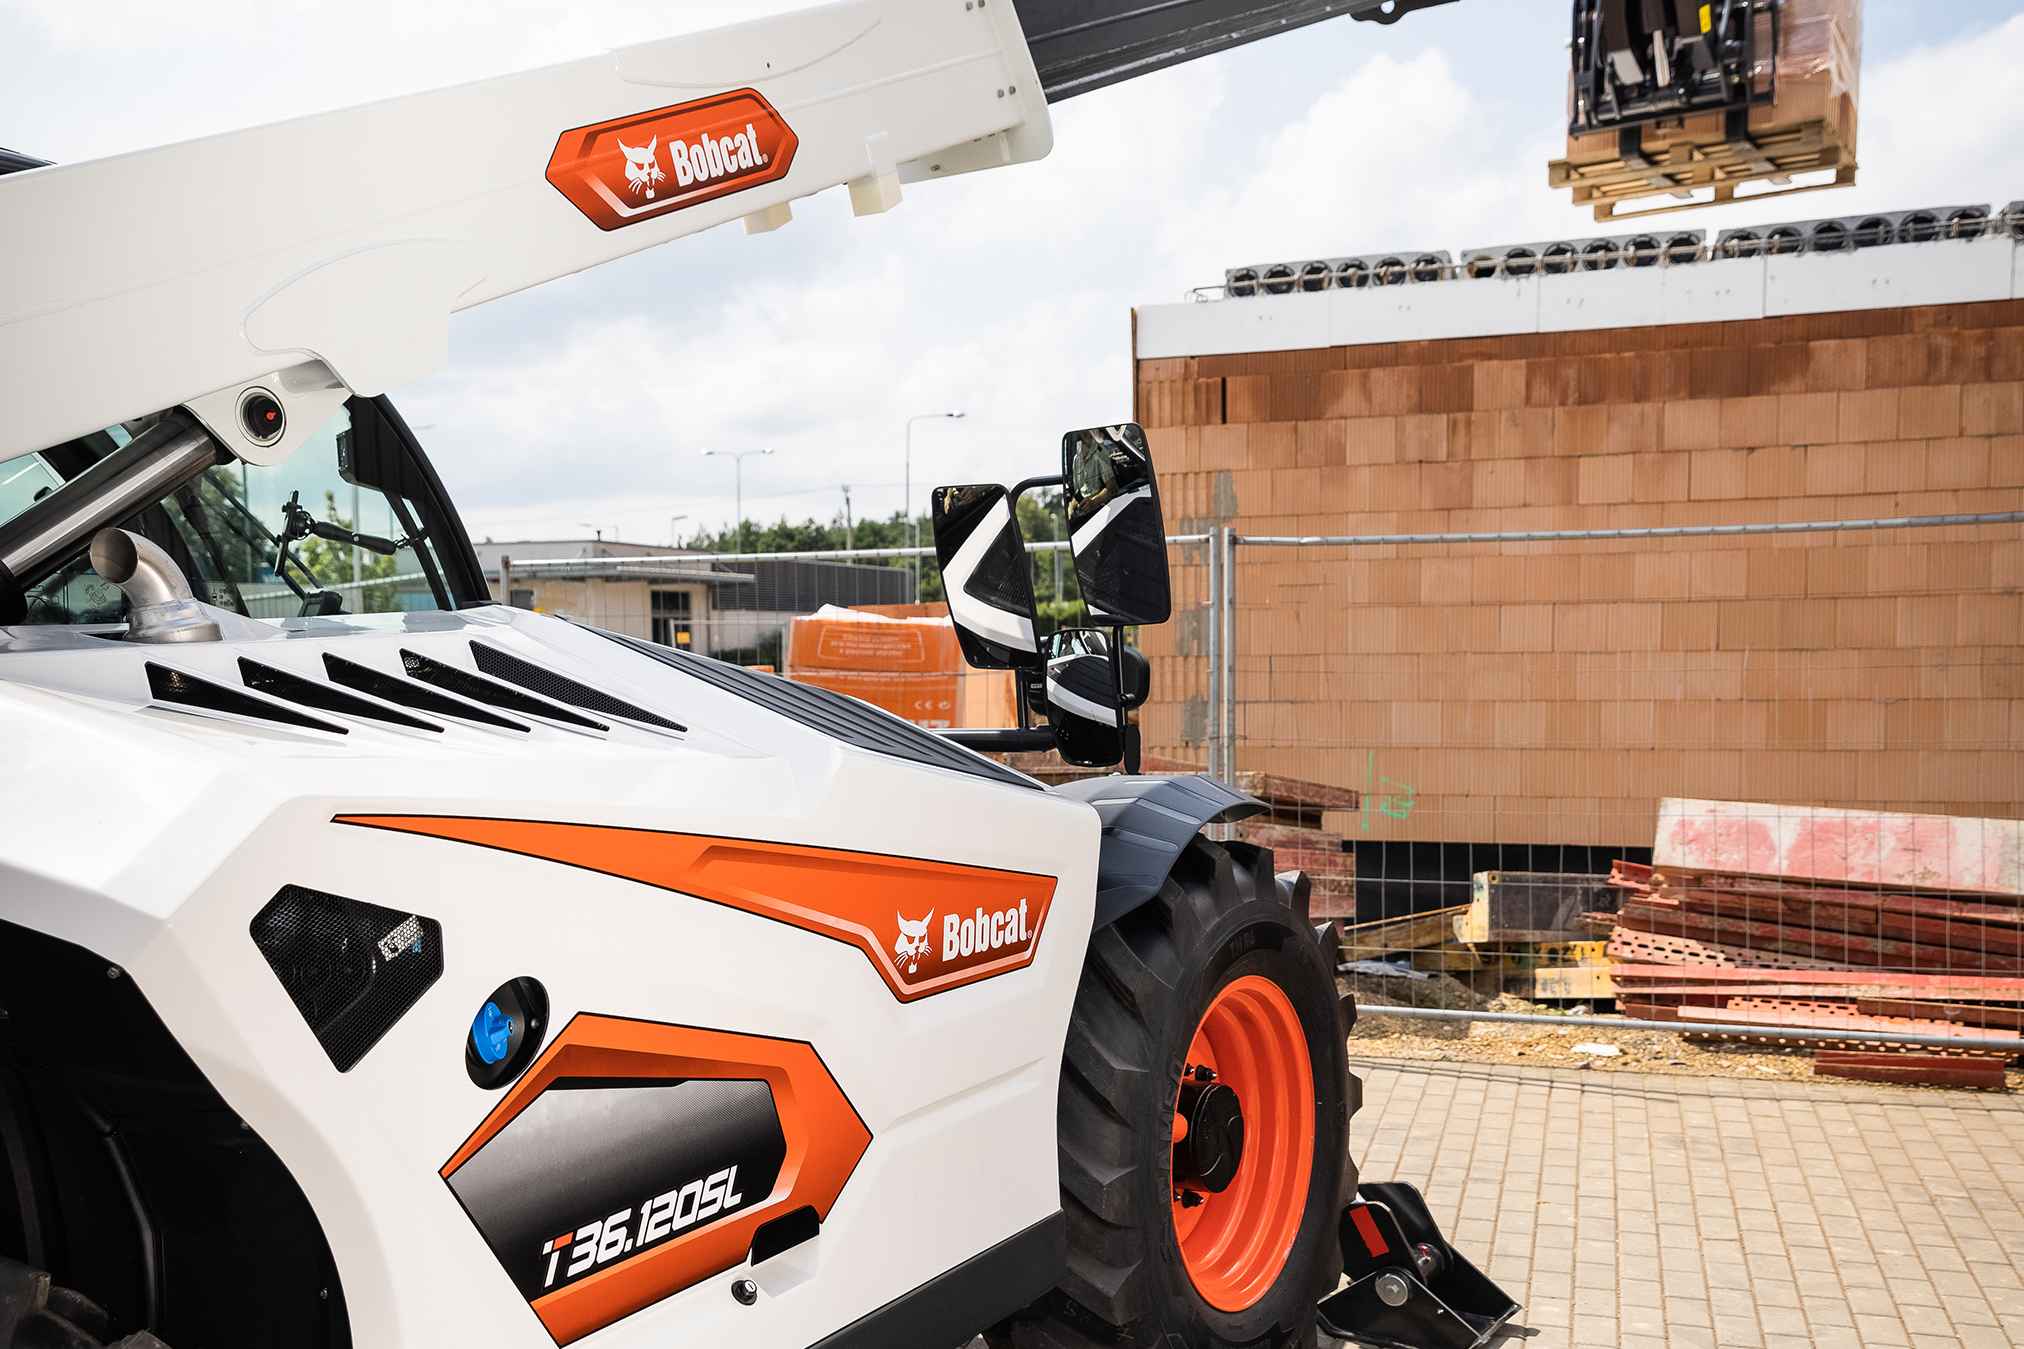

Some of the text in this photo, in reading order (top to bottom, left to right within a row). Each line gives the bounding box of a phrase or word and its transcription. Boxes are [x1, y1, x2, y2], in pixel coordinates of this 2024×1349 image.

[669, 123, 764, 187] Bobcat
[942, 898, 1028, 962] Bobcat
[542, 1164, 743, 1288] T36.120SL
